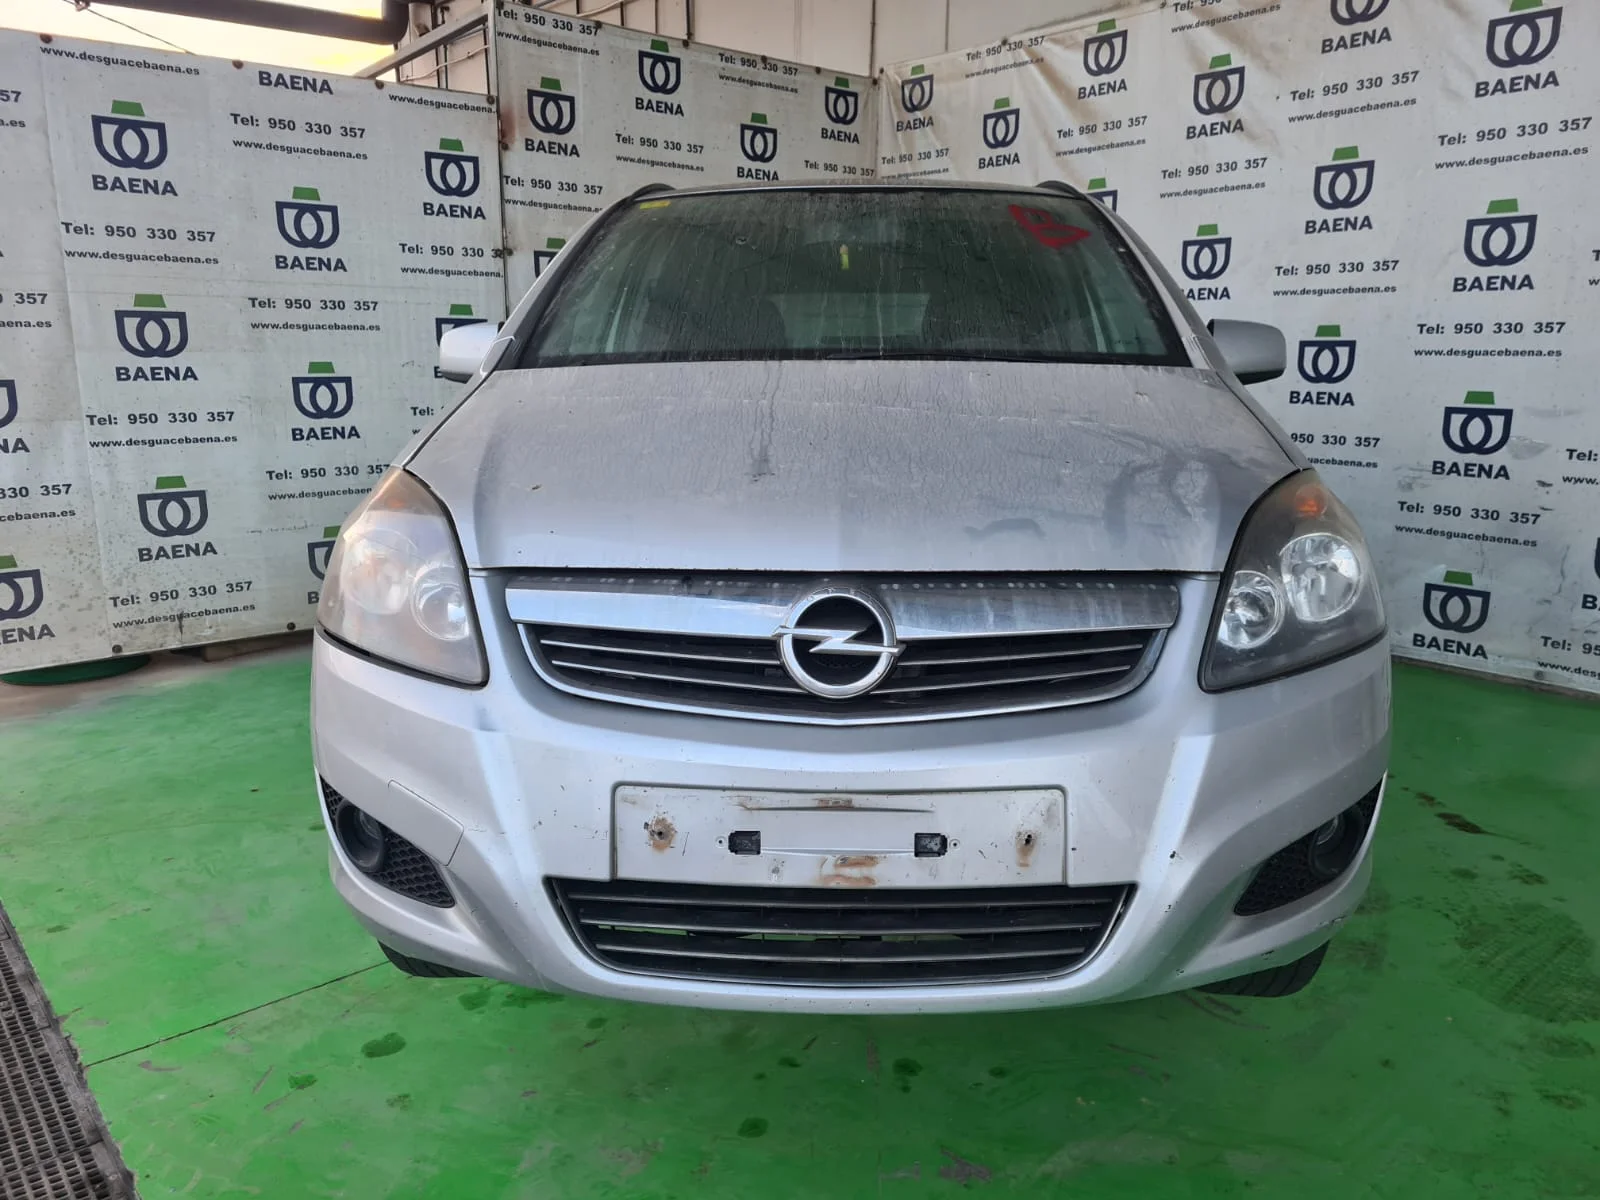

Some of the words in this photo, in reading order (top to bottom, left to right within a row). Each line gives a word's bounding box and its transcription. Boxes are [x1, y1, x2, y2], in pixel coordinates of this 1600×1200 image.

[1172, 0, 1194, 13] Tel:
[523, 12, 546, 26] 950
[552, 18, 573, 32] 330
[578, 23, 599, 37] 357
[1170, 3, 1282, 34] www.desguacebaena.es
[496, 29, 601, 57] www.desguacebaena.es
[965, 50, 982, 62] Tel:
[985, 44, 1002, 58] 950
[1005, 39, 1024, 53] 330
[1027, 35, 1046, 49] 357
[1320, 26, 1393, 55] BAENA
[39, 46, 200, 76] www.desguacebaena.es
[717, 52, 736, 65] Tel:
[740, 56, 758, 69] 950
[761, 61, 779, 74] 330
[782, 65, 799, 76] 357
[258, 70, 334, 96] BAENA
[1076, 78, 1128, 101] BAENA
[1290, 88, 1315, 102] Tel:
[1322, 81, 1349, 97] 950
[1356, 76, 1383, 91] 330
[1391, 70, 1420, 86] 357
[1474, 70, 1560, 99] BAENA
[0, 89, 22, 103] 57
[388, 92, 499, 115] www.desguacebaena.
[635, 96, 685, 117] BAENA
[1287, 94, 1417, 124] www.desguacebaena.es
[229, 112, 260, 127] Tel:
[267, 117, 296, 132] 950
[304, 121, 332, 136] 330
[339, 125, 366, 139] 357
[895, 115, 935, 133] BAENA
[1056, 127, 1074, 139] Tel:
[1078, 123, 1098, 136] 950
[1102, 119, 1122, 132] 330
[1127, 115, 1148, 128] 357
[1185, 118, 1245, 140] BAENA
[1437, 132, 1467, 147] Tel:
[1476, 127, 1507, 143] 950
[1516, 122, 1549, 138] 330
[1558, 116, 1593, 133] 357
[615, 132, 634, 145] Tel:
[639, 136, 658, 149] 950
[663, 140, 682, 152] 330
[686, 143, 705, 155] 357
[820, 127, 860, 145] BAENA
[232, 139, 368, 161] www.desguacebaena.es
[524, 137, 581, 158] BAENA
[881, 155, 896, 165] Tel:
[917, 150, 932, 161] 330
[935, 147, 950, 159] 357
[803, 159, 820, 170] Tel:
[823, 162, 839, 173] 950
[842, 165, 857, 176] 330
[860, 167, 875, 177] 357
[978, 152, 1021, 170] BAENA
[1161, 167, 1182, 180] Tel:
[1187, 164, 1209, 177] 950
[1215, 160, 1238, 174] 330
[1244, 156, 1268, 170] 357
[1434, 146, 1589, 170] www.desguacebaena.es
[736, 166, 780, 182] BAENA
[91, 174, 179, 197] BAENA
[503, 175, 525, 188] Tel:
[530, 178, 552, 190] 950
[557, 181, 578, 193] 330
[583, 184, 603, 195] 357
[1159, 181, 1266, 199] www.desguacebaena.es
[422, 201, 487, 221] BAENA
[60, 221, 95, 236] Tel:
[104, 224, 137, 238] 950
[146, 227, 177, 241] 330
[186, 230, 216, 243] 357
[1304, 215, 1373, 235] BAENA
[64, 250, 219, 265] www.desguacebaena.es
[398, 242, 424, 255] Tel:
[430, 244, 455, 257] 950
[461, 246, 485, 258] 330
[274, 254, 348, 273] BAENA
[400, 266, 504, 279] www.desguacebaena.
[1274, 265, 1299, 277] Tel:
[1305, 263, 1331, 276] 950
[1338, 261, 1365, 274] 330
[1372, 259, 1400, 272] 357
[1184, 286, 1231, 301] AENA
[1272, 285, 1397, 297] www.desguacebaena.es
[1452, 274, 1535, 293] BAENA
[14, 292, 48, 305] 357
[247, 297, 277, 309] Tel:
[284, 298, 312, 310] 950
[319, 299, 346, 311] 330
[353, 300, 379, 312] 357
[250, 321, 381, 332] www.desguacebaena.es
[1416, 323, 1445, 335] Tel:
[1454, 322, 1484, 335] 950
[1492, 322, 1524, 334] 330
[1533, 321, 1566, 334] 357
[1413, 347, 1562, 359] www.desguacebaena.es
[115, 366, 199, 382] BAENA
[1288, 390, 1355, 407] BAENA
[85, 413, 118, 426] Tel:
[127, 412, 159, 425] 950
[167, 411, 198, 424] 330
[206, 411, 235, 423] 357
[410, 406, 434, 417] Tel:
[88, 435, 238, 448] www.desguacebaena.es
[291, 425, 361, 442] BAENA
[1290, 432, 1315, 444] 950
[1321, 434, 1347, 446] 330
[1354, 436, 1381, 448] 357
[1306, 457, 1378, 469] uacebaena.es
[1565, 448, 1599, 462] Tel:
[265, 469, 293, 481] Tel:
[300, 467, 327, 479] 950
[334, 465, 360, 477] 330
[1431, 460, 1511, 481] BAENA
[39, 483, 73, 497] 357
[267, 487, 373, 501] www.desguacebaen
[1397, 500, 1425, 514] Tel:
[1433, 504, 1462, 518] 950
[1470, 507, 1500, 521] 330
[1509, 511, 1541, 525] 357
[1394, 525, 1538, 548] www.desguacebaena.es
[137, 541, 218, 563] BAENA
[108, 594, 141, 608] Tel:
[149, 589, 180, 603] 950
[188, 584, 217, 598] 330
[225, 580, 253, 594] 357
[111, 602, 256, 630] www.desguacebaena.es
[0, 623, 56, 646] ENA
[1412, 632, 1489, 660] BAENA
[1540, 635, 1572, 652] Tel:
[1582, 642, 1600, 657] 95
